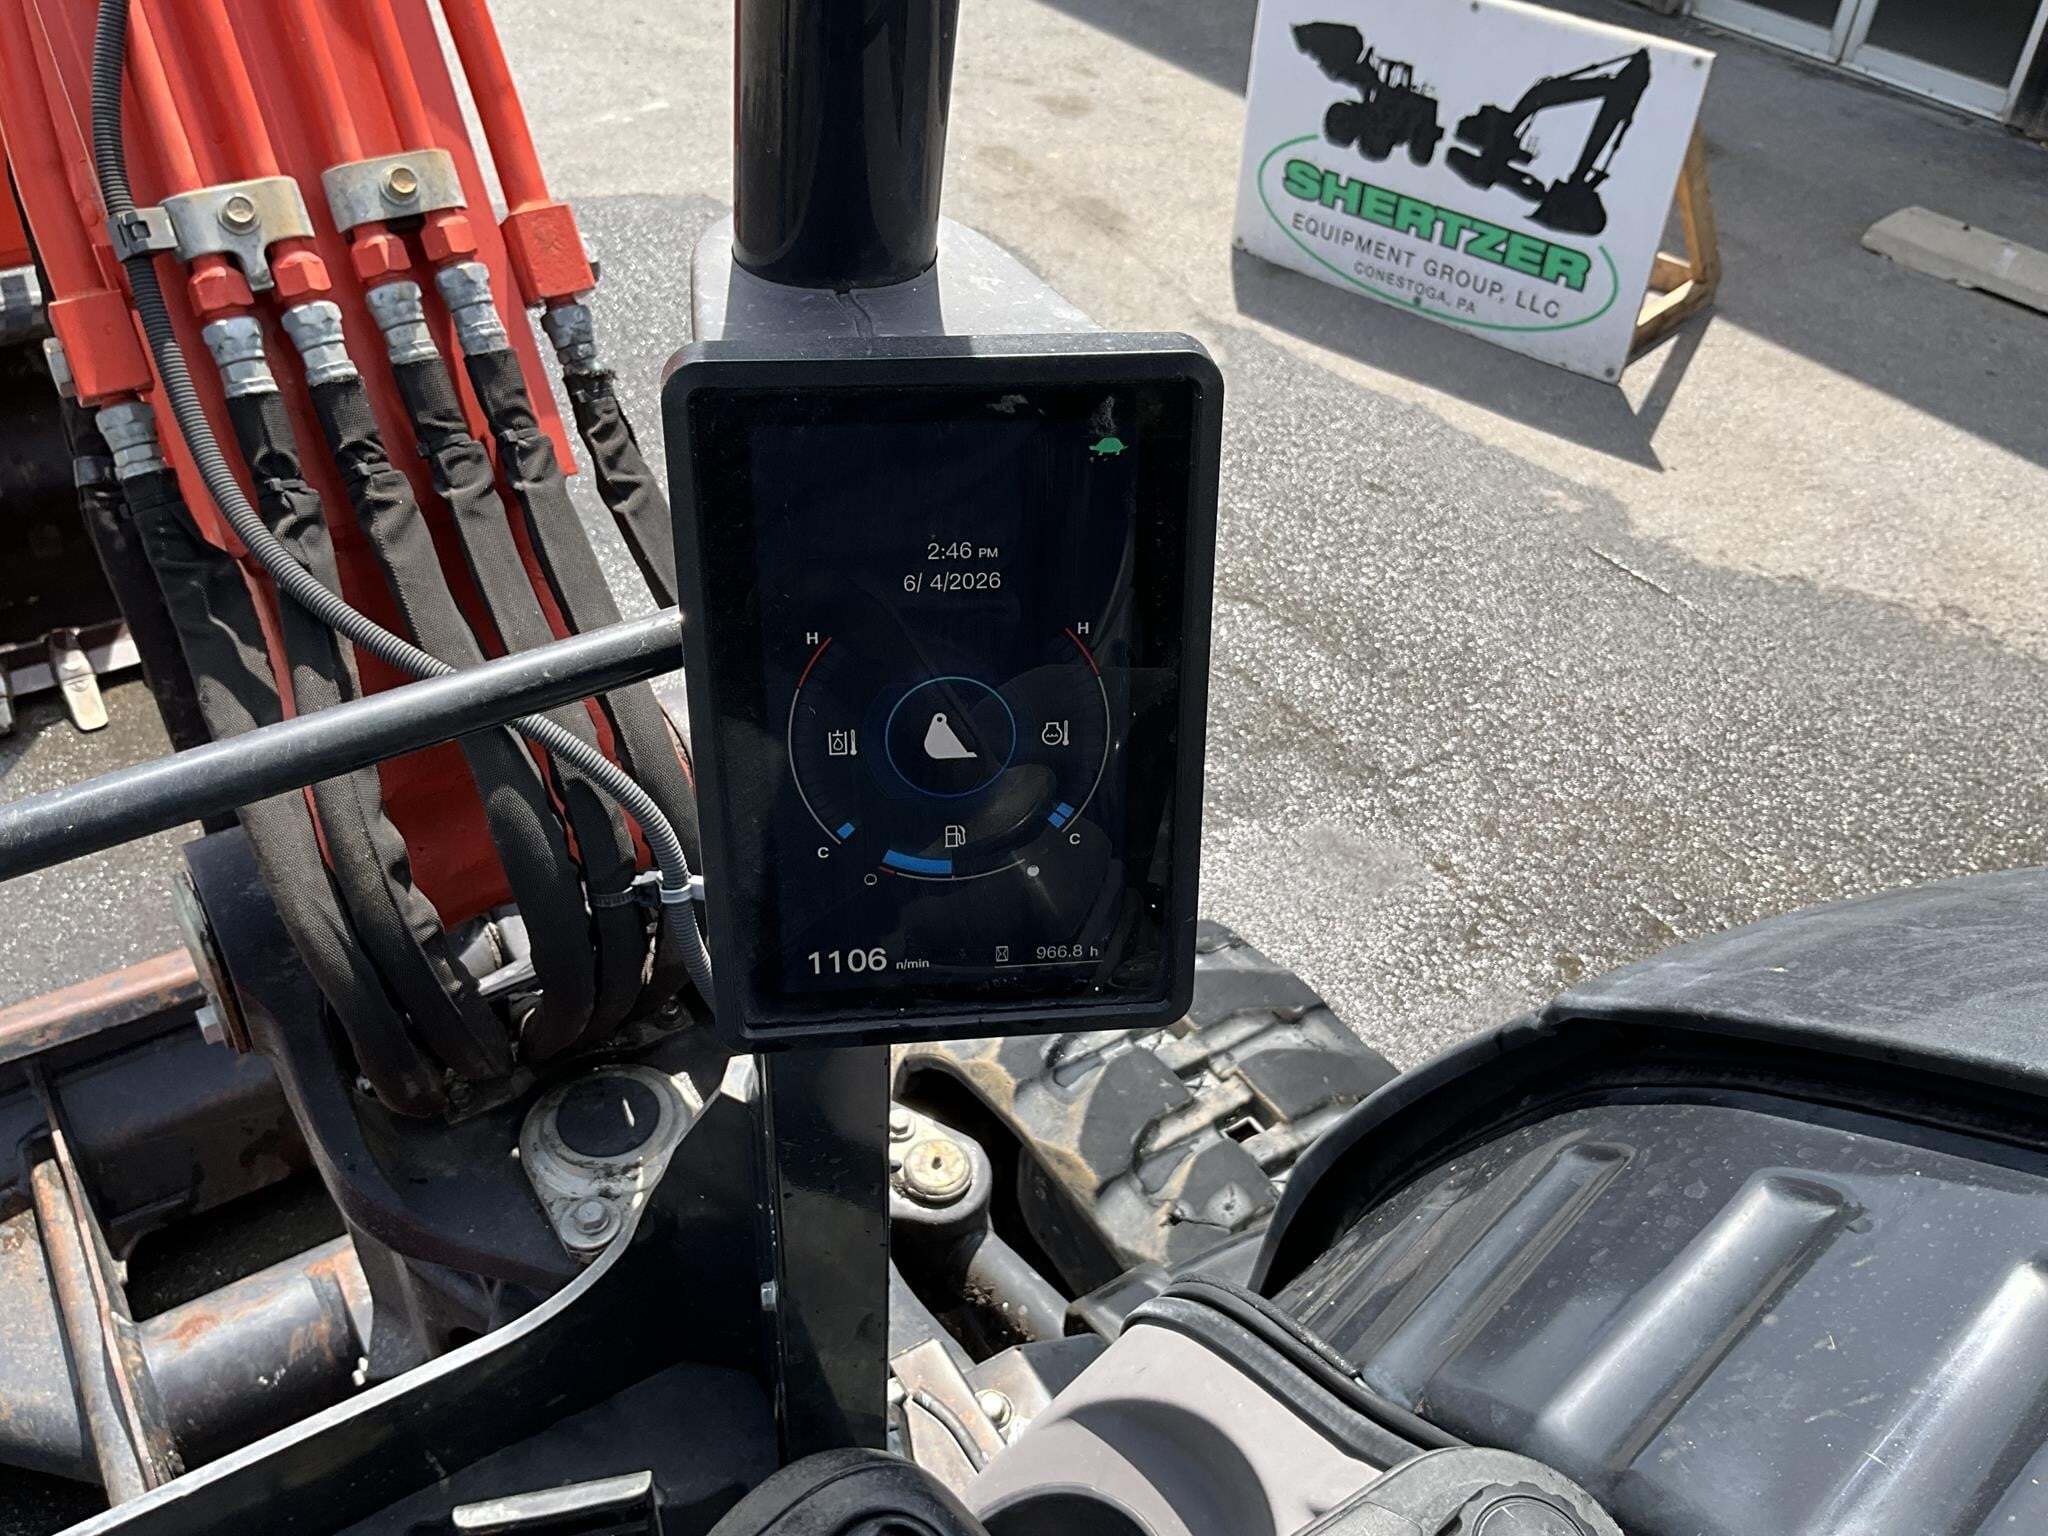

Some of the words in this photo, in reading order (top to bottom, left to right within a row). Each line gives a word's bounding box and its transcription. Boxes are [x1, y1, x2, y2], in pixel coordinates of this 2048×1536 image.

[1283, 159, 1592, 292] SHERTZER
[1292, 212, 1417, 273] EQUIPMENT
[1423, 259, 1504, 305] GROUP,
[1515, 288, 1560, 319] LLC
[1353, 261, 1452, 310] CONESTOGA,
[1457, 296, 1476, 315] PA
[927, 542, 972, 560] 2:46
[978, 547, 999, 559] PM
[1077, 621, 1090, 635] H
[806, 631, 819, 645] H
[1069, 832, 1081, 845] C
[817, 846, 830, 859] C
[1036, 944, 1083, 960] 966.8
[1089, 945, 1099, 957] h
[807, 947, 888, 975] 1106
[895, 958, 930, 971] n/min
